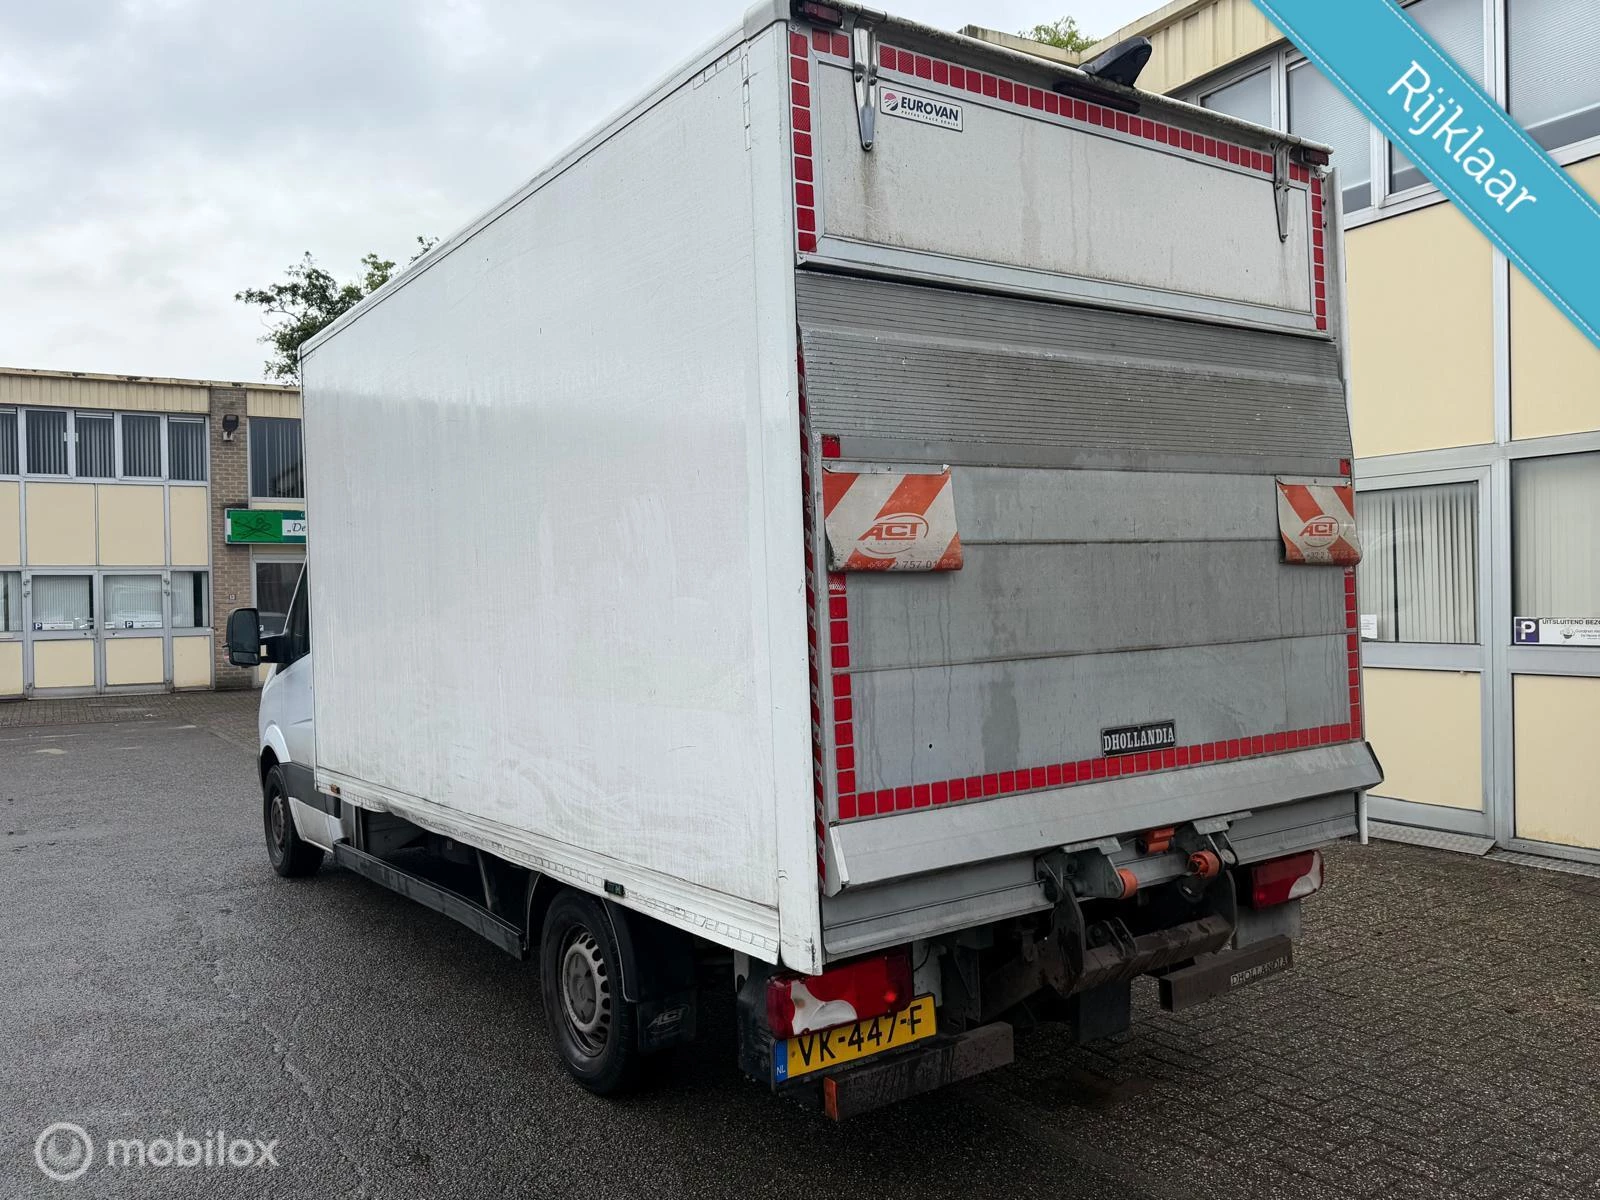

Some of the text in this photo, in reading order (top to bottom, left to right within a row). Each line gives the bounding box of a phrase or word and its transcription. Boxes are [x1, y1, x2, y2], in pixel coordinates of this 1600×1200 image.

[901, 96, 959, 121] EUROVAN
[1521, 621, 1536, 640] P
[1103, 727, 1175, 751] DHOLLANDIA
[798, 1004, 922, 1067] VK-447-F
[776, 1066, 786, 1076] NL
